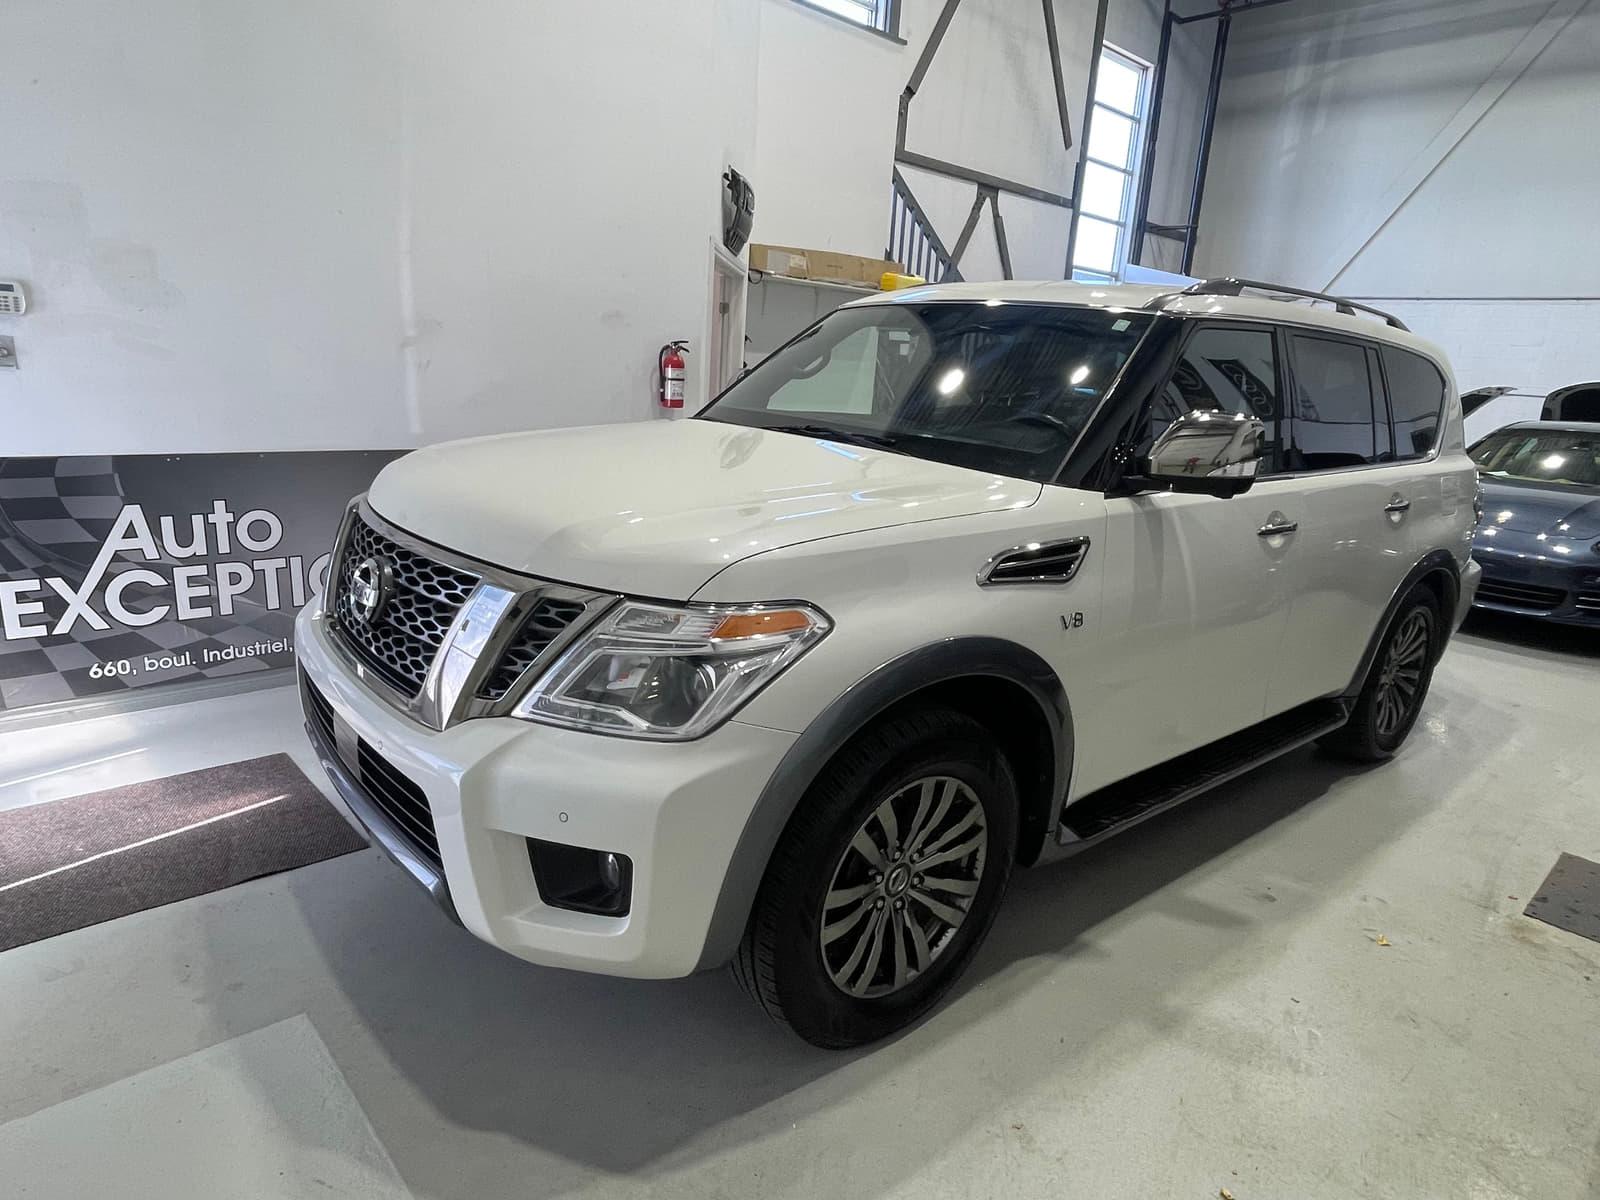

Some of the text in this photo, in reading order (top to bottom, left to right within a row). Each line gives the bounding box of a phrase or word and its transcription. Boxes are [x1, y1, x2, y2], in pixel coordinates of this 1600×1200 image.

[108, 499, 284, 561] Auto
[1060, 611, 1084, 631] V8
[88, 638, 293, 679] 660, boul. Industriel,
